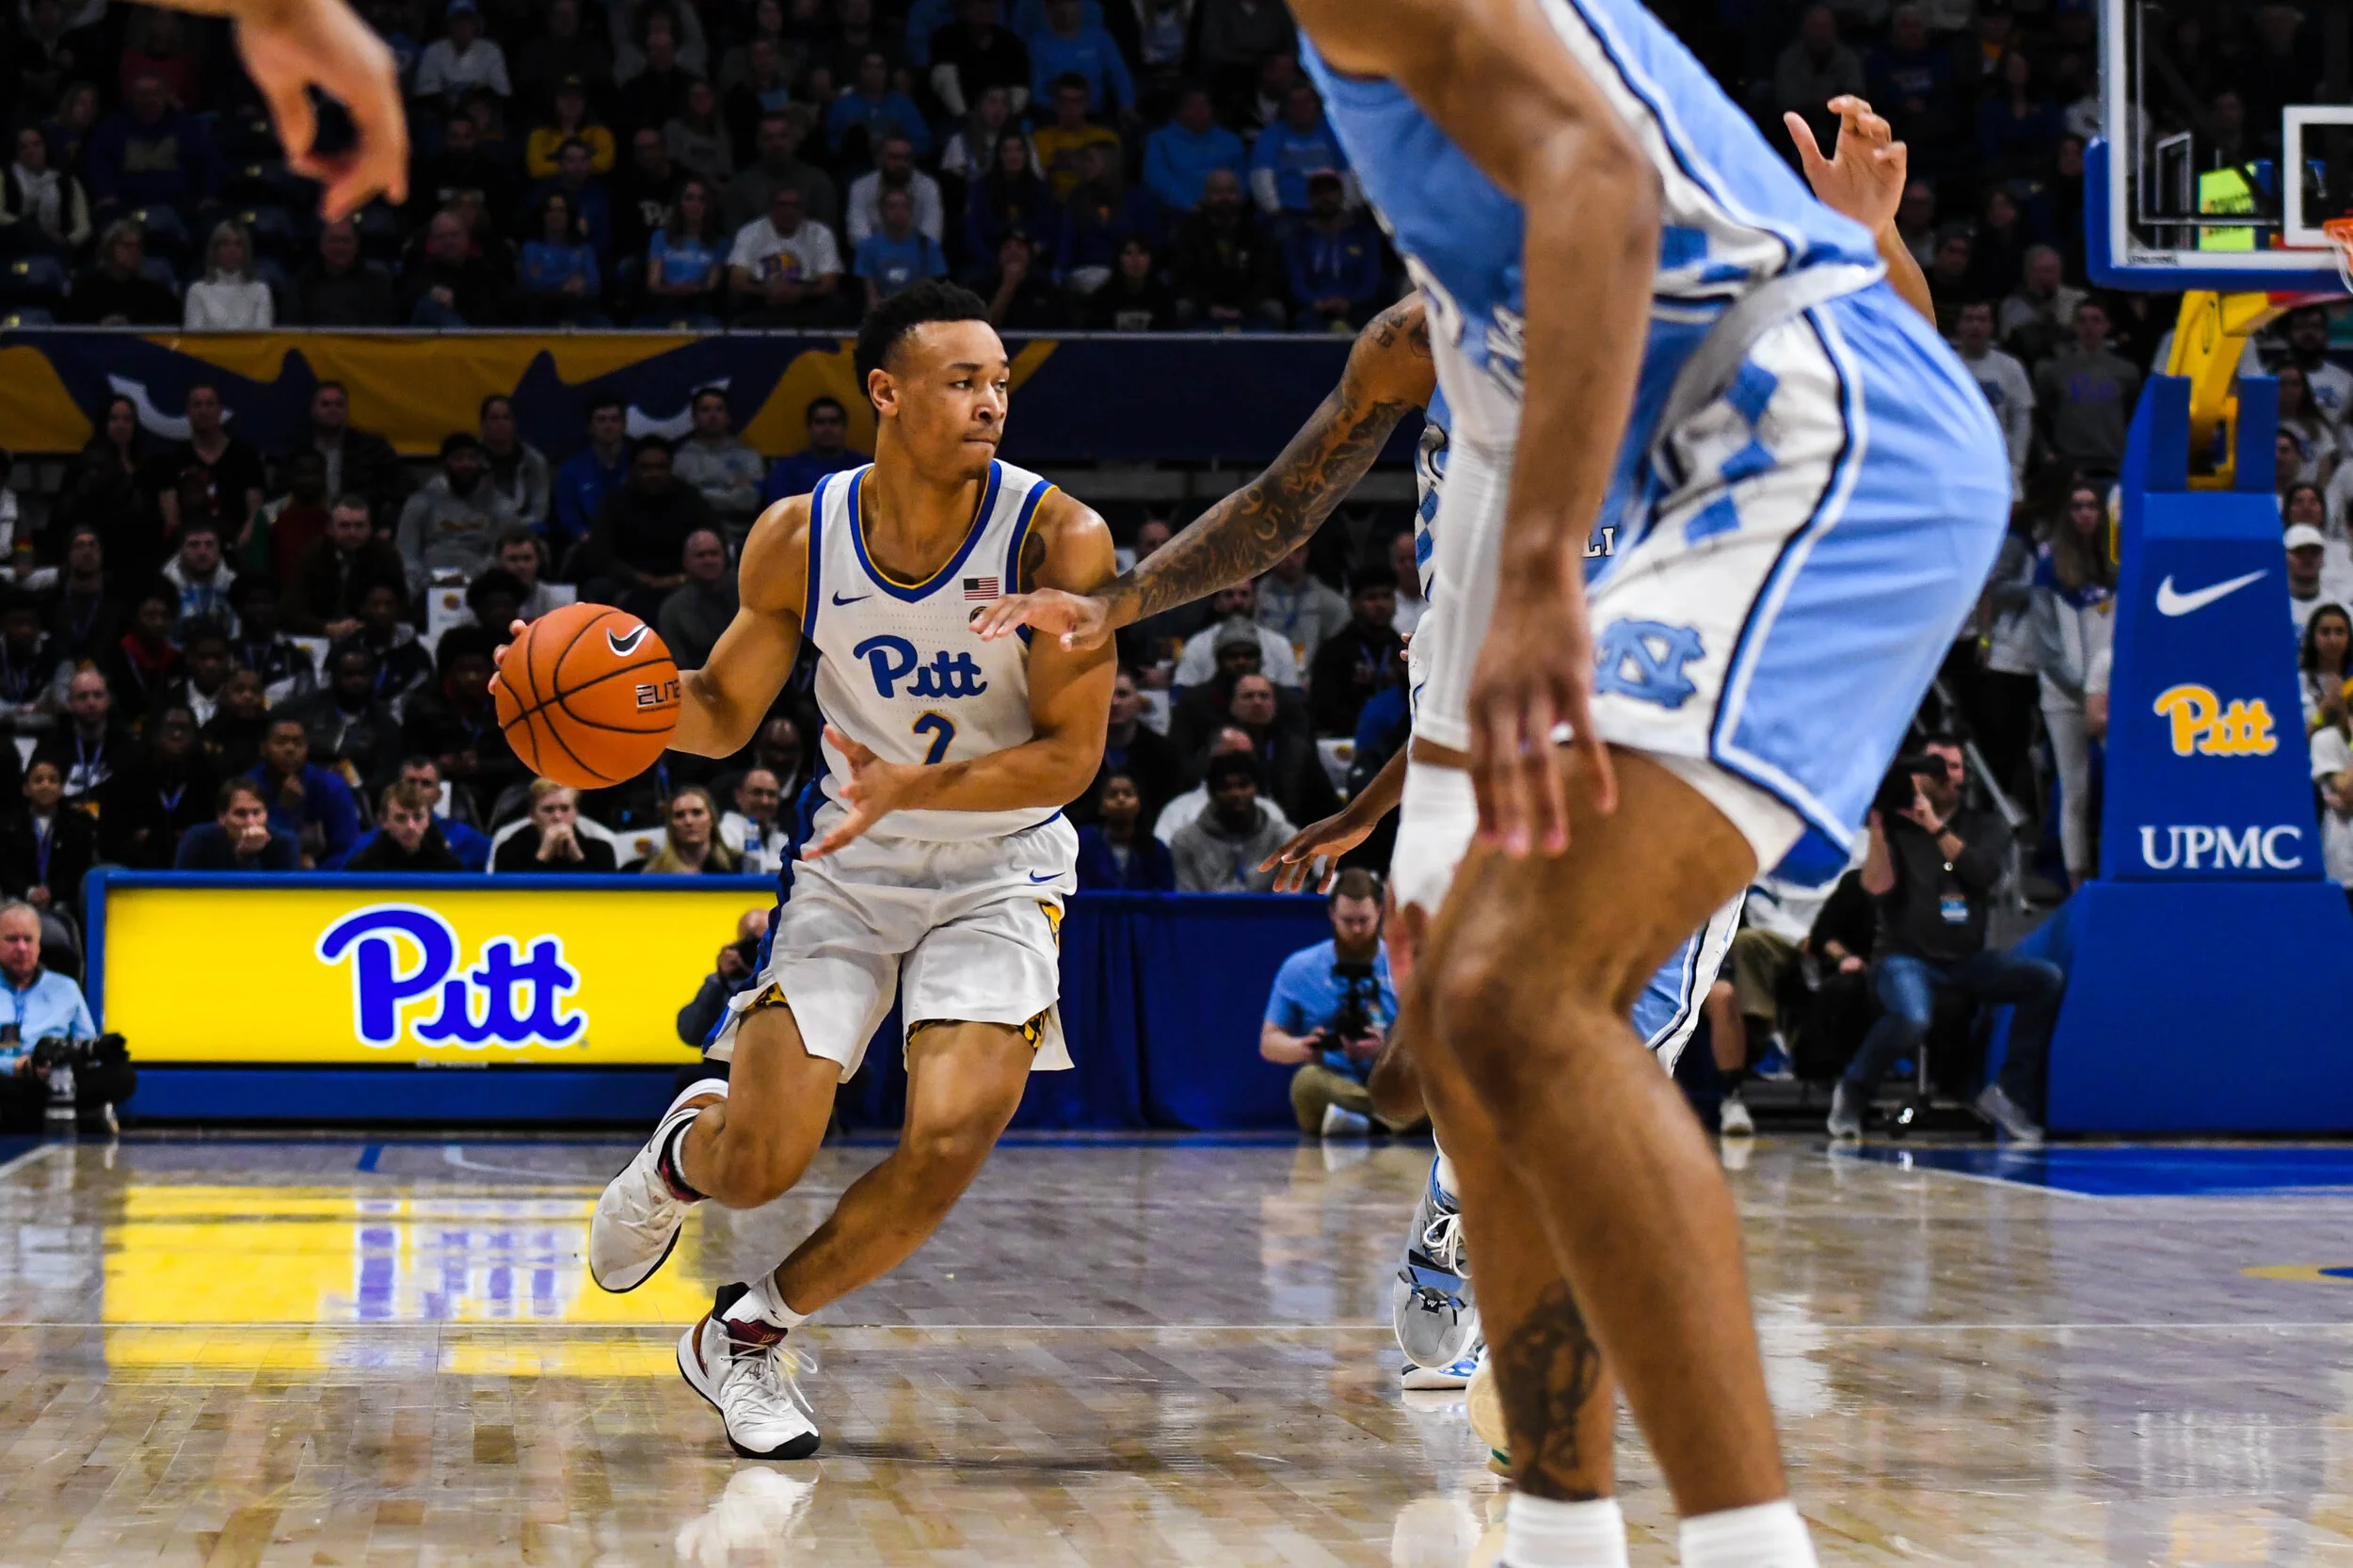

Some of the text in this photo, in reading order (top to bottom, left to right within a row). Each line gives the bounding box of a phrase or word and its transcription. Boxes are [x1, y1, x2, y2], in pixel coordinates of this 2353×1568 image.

[853, 633, 987, 698] Pitt
[911, 709, 956, 765] 2
[2153, 683, 2279, 757] Pitt
[2138, 824, 2302, 870] UPMC
[314, 903, 588, 1050] Pitt
